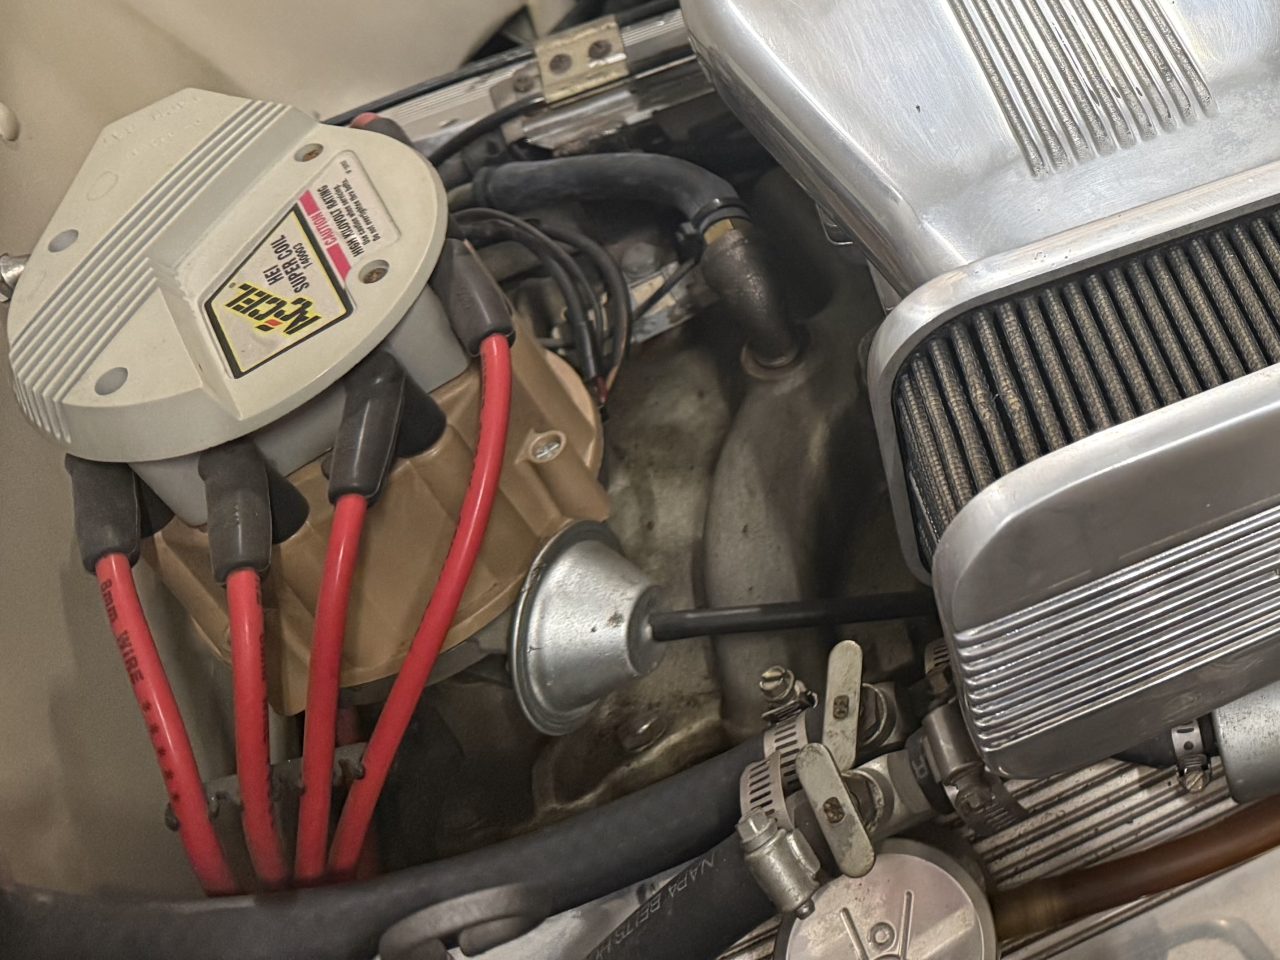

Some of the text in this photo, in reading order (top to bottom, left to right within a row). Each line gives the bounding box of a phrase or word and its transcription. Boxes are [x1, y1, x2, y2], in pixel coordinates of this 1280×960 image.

[310, 211, 337, 246] CAUTION
[317, 184, 365, 258] HIGH KILOVOLT RATING
[263, 264, 284, 286] HEI
[270, 234, 310, 293] SUPER COIL
[292, 242, 313, 269] 140003
[225, 283, 322, 335] ACCEL
[100, 578, 144, 685] 8mm WIRE
[667, 851, 716, 898] NAPA
